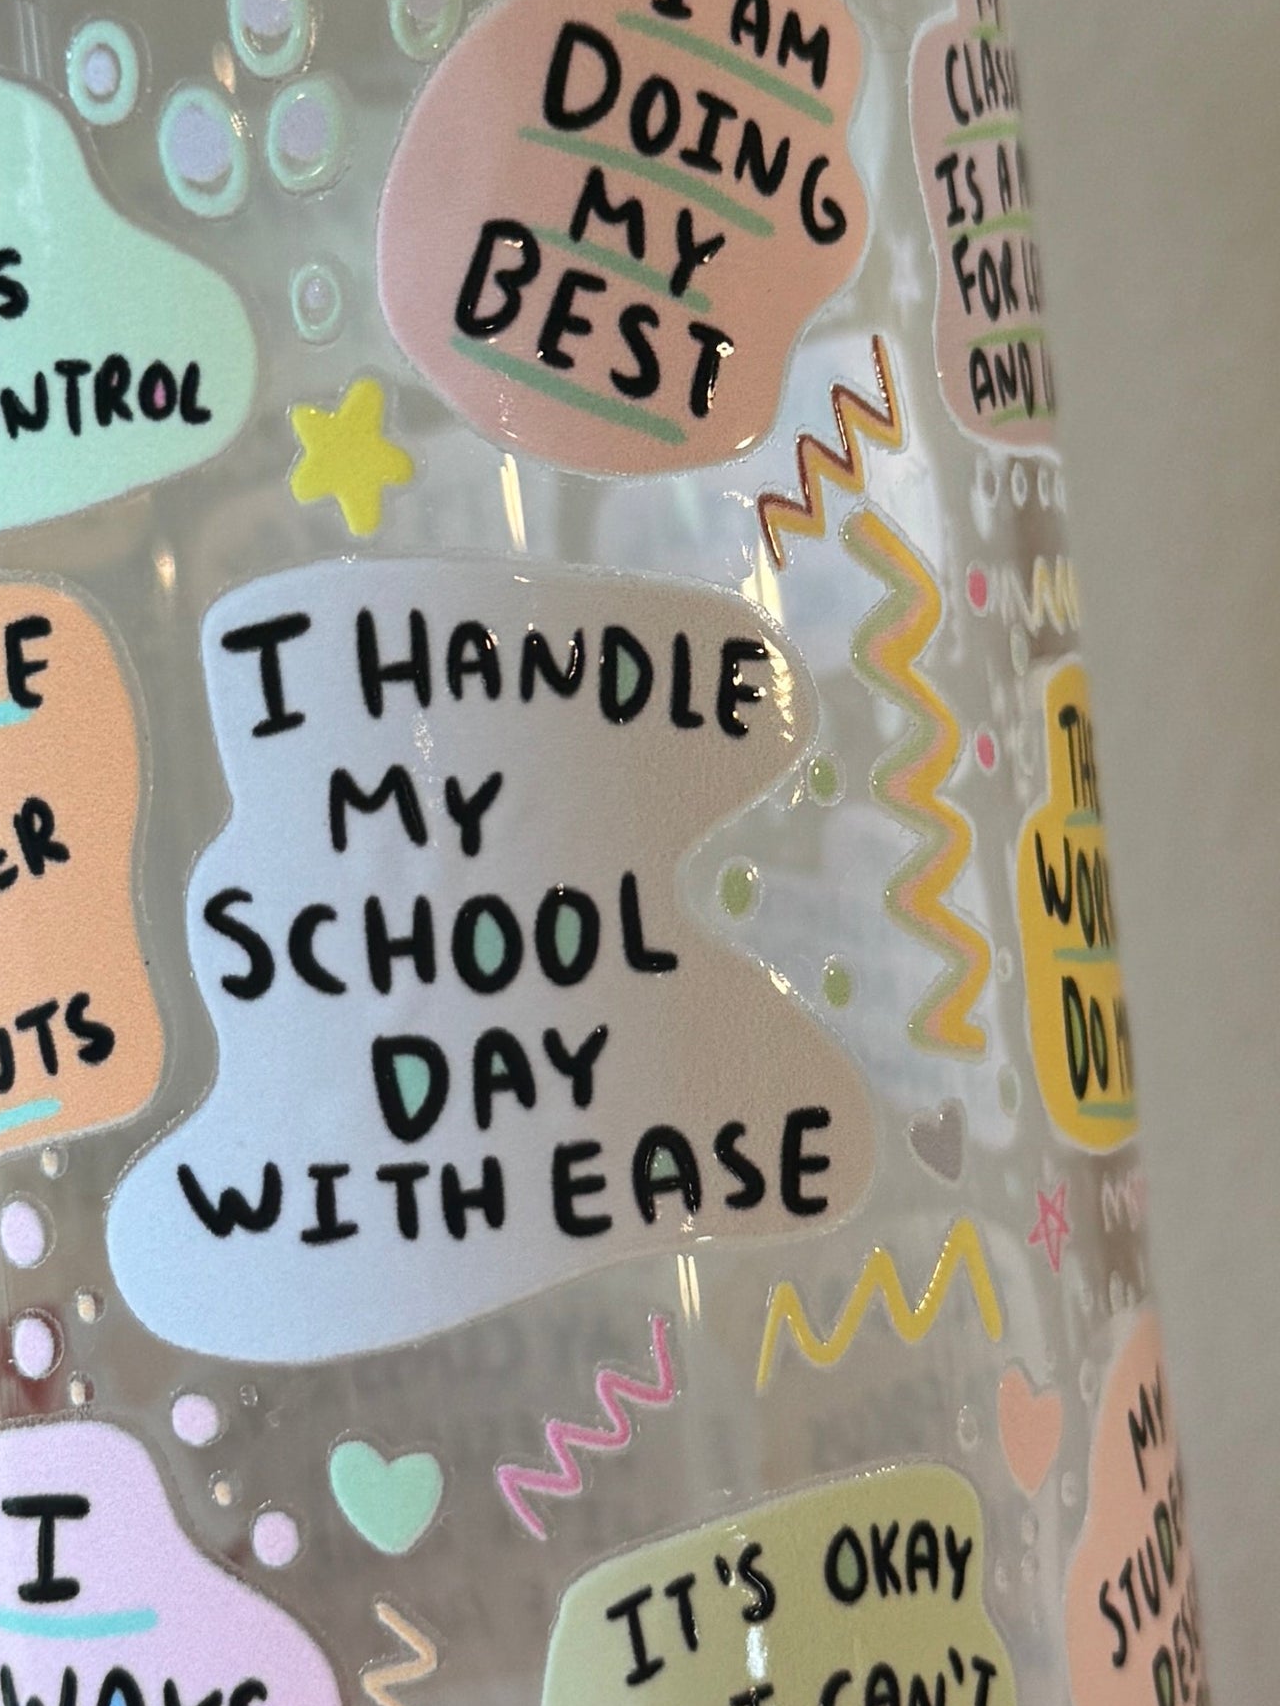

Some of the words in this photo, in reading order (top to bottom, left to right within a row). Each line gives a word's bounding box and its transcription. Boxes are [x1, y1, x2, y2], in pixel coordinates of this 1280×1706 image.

[543, 21, 847, 246] DOING
[935, 151, 984, 227] IS
[570, 165, 725, 296] MY
[952, 234, 1019, 322] FOR
[455, 219, 734, 419] BEST
[970, 339, 1034, 419] AND
[221, 612, 311, 738] I
[356, 607, 768, 738] HANDLE
[328, 764, 503, 856] MY
[203, 870, 678, 1001] SCHOOL
[372, 1024, 609, 1143] DAY
[1062, 976, 1108, 1099] DO
[177, 1155, 505, 1245] WITH
[552, 1105, 832, 1239] EASE
[1, 1493, 90, 1604] I
[606, 1541, 776, 1687] IT'S
[824, 1519, 973, 1605] OKAY
